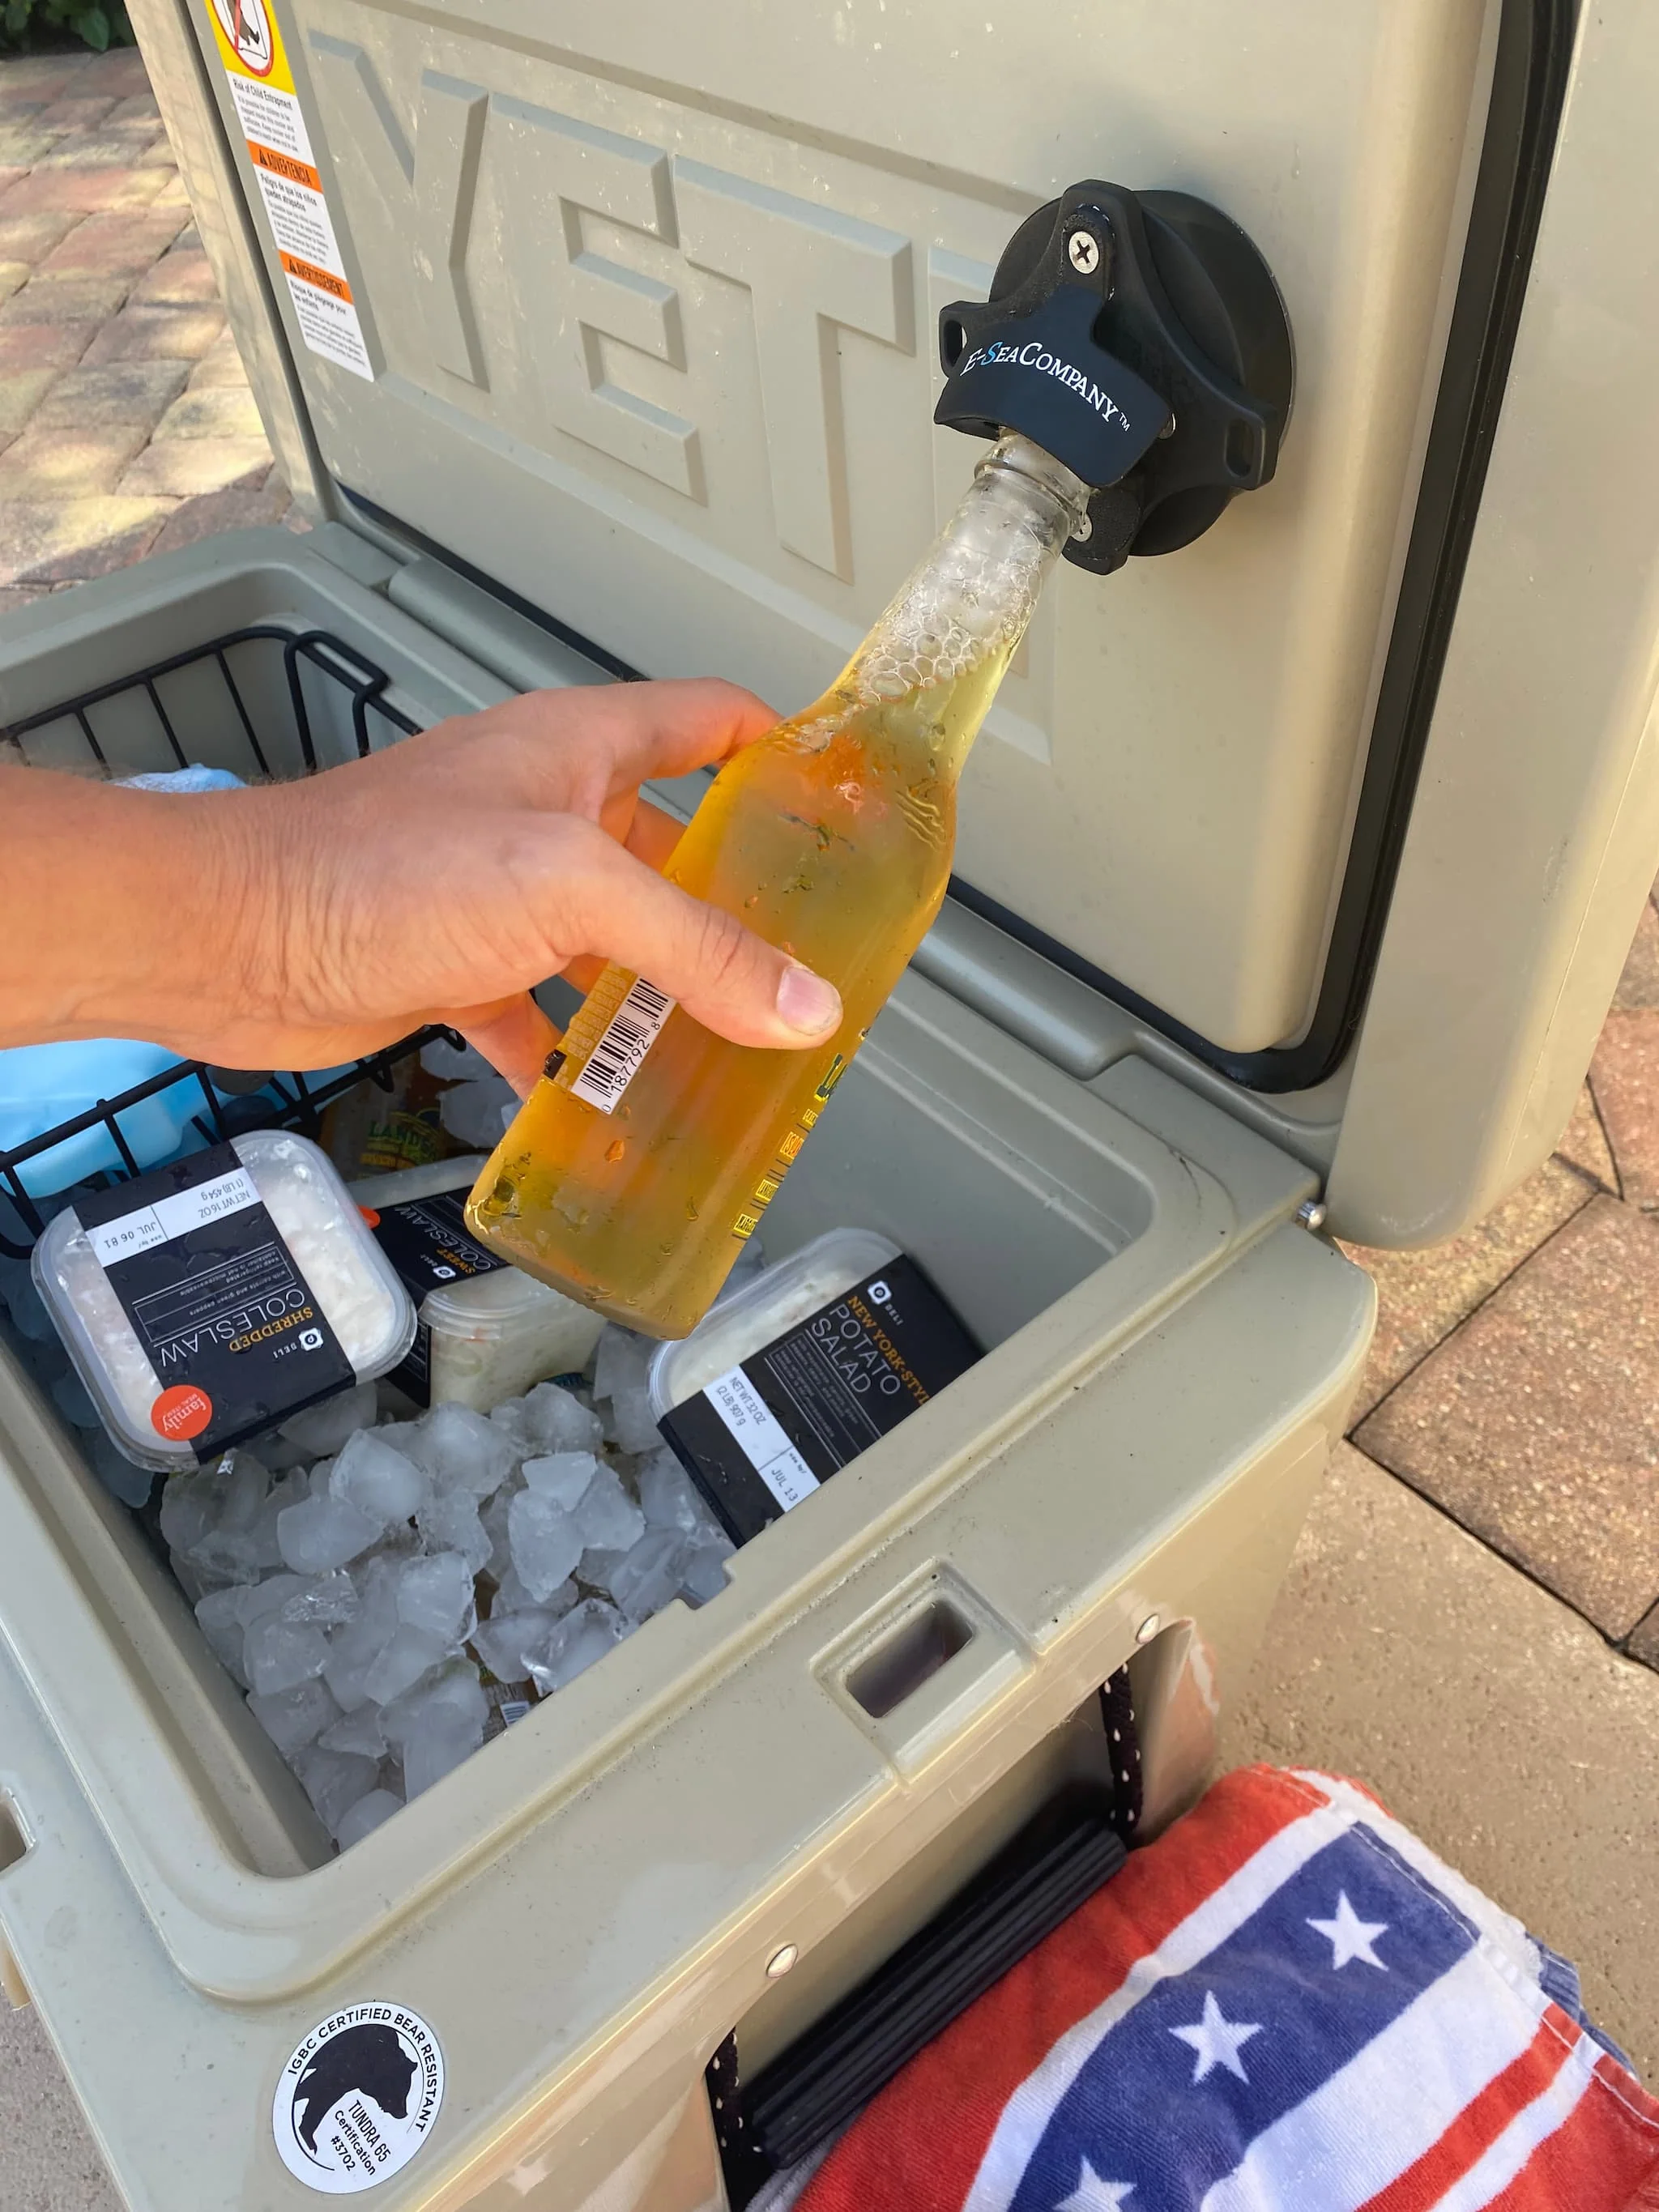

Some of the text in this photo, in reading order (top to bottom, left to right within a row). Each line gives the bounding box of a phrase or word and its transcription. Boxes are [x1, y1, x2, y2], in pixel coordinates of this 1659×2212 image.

[610, 1038, 650, 1092] 187792
[650, 1021, 661, 1030] 8
[197, 1189, 251, 1219] NET WT 16 OZ
[207, 1188, 222, 1200] 454
[120, 1230, 134, 1242] 06
[136, 1221, 156, 1235] JUL
[394, 1206, 491, 1271] COLESLAW
[236, 1286, 248, 1296] and
[161, 1288, 305, 1367] COLESLAW
[229, 1306, 313, 1352] SHREDDED
[272, 1341, 297, 1359] DELI
[829, 1302, 902, 1396] POTATO
[811, 1318, 872, 1395] SALAD
[847, 1295, 931, 1407] NEW YORK-STYL
[162, 1397, 207, 1432] family
[730, 1377, 744, 1392] NET
[745, 1402, 758, 1414] 32
[753, 1412, 767, 1426] OZ
[730, 1404, 744, 1417] 907
[771, 1469, 799, 1502] JUL 13
[288, 2008, 438, 2133] IGBC CERTIFIED BEAR RESISTANT
[330, 2135, 356, 2172] #3702
[335, 2110, 376, 2176] Certification
[348, 2099, 392, 2163] TUNDRA 65
